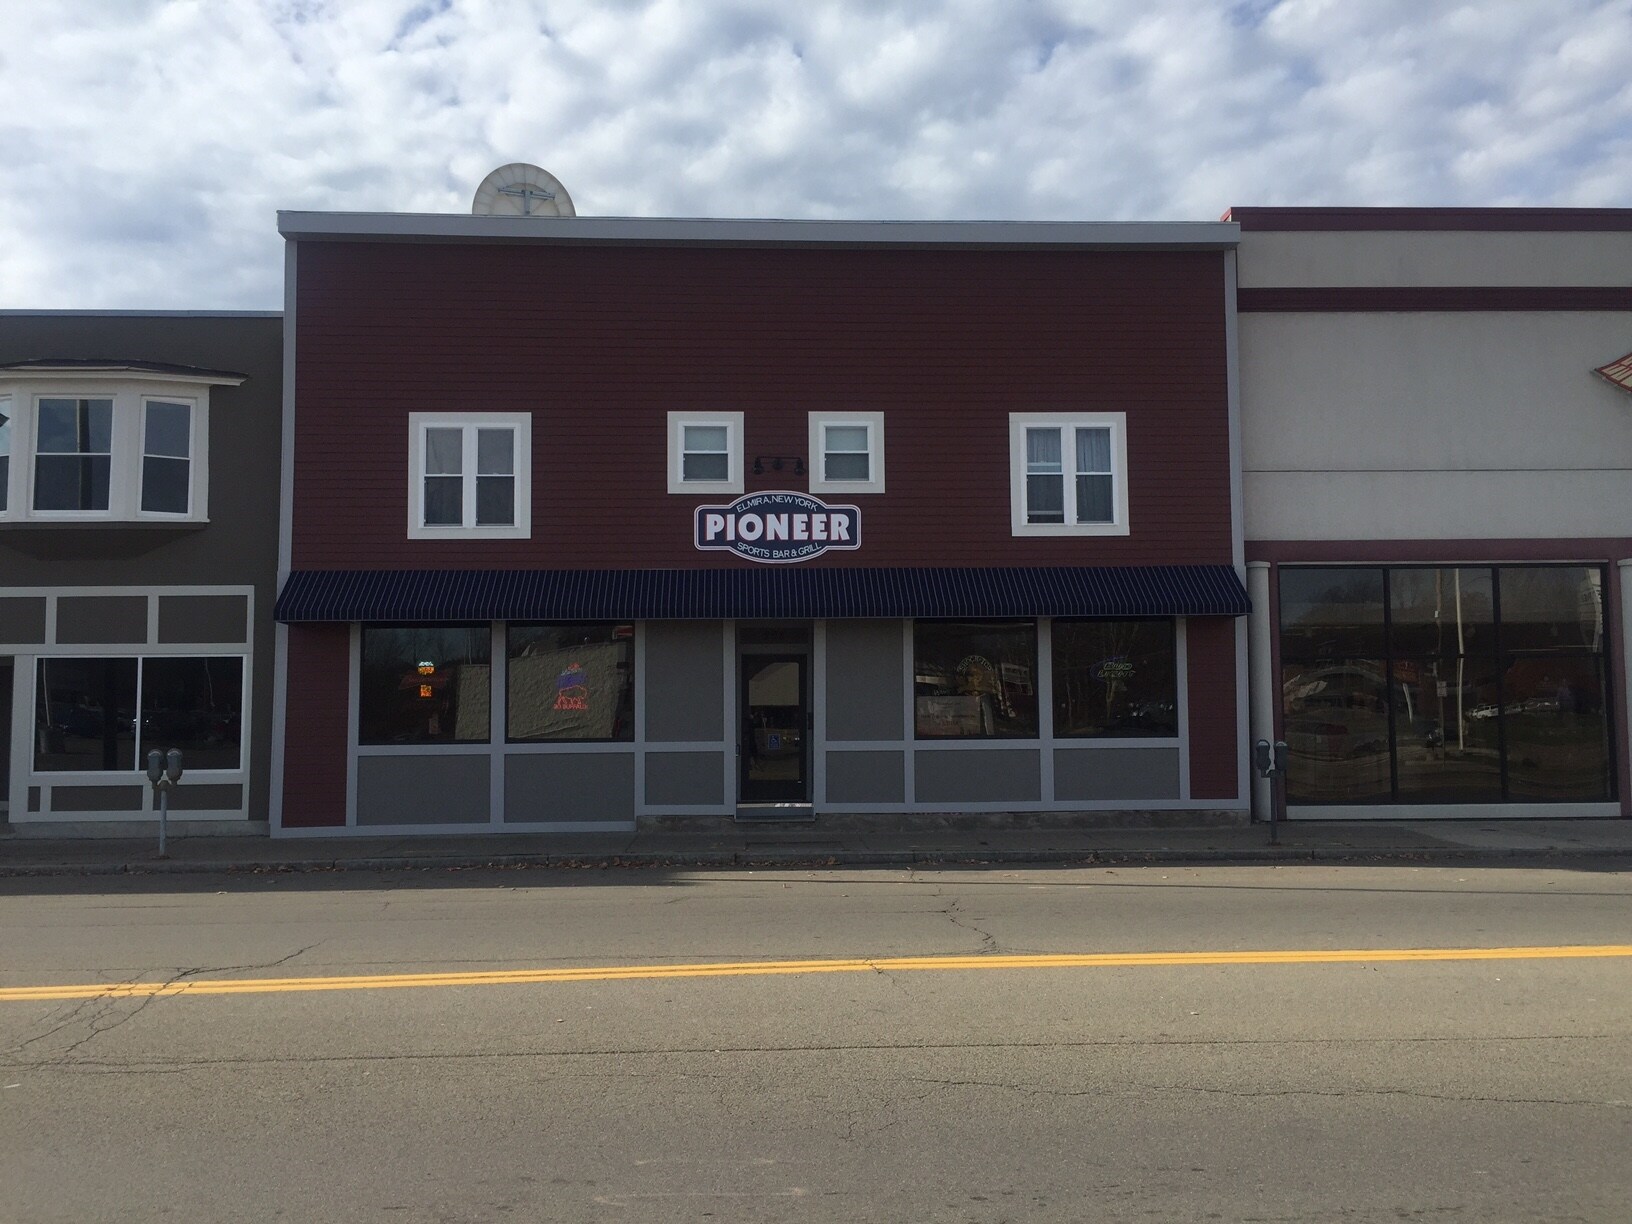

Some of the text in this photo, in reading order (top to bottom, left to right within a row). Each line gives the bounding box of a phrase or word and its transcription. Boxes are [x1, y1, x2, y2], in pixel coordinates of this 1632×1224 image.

[736, 495, 818, 513] ELMIRA, NEW YORK
[705, 513, 850, 541] PIONEER
[736, 541, 770, 558] SPORTS
[772, 550, 790, 558] BAR
[798, 542, 822, 556] GRILL
